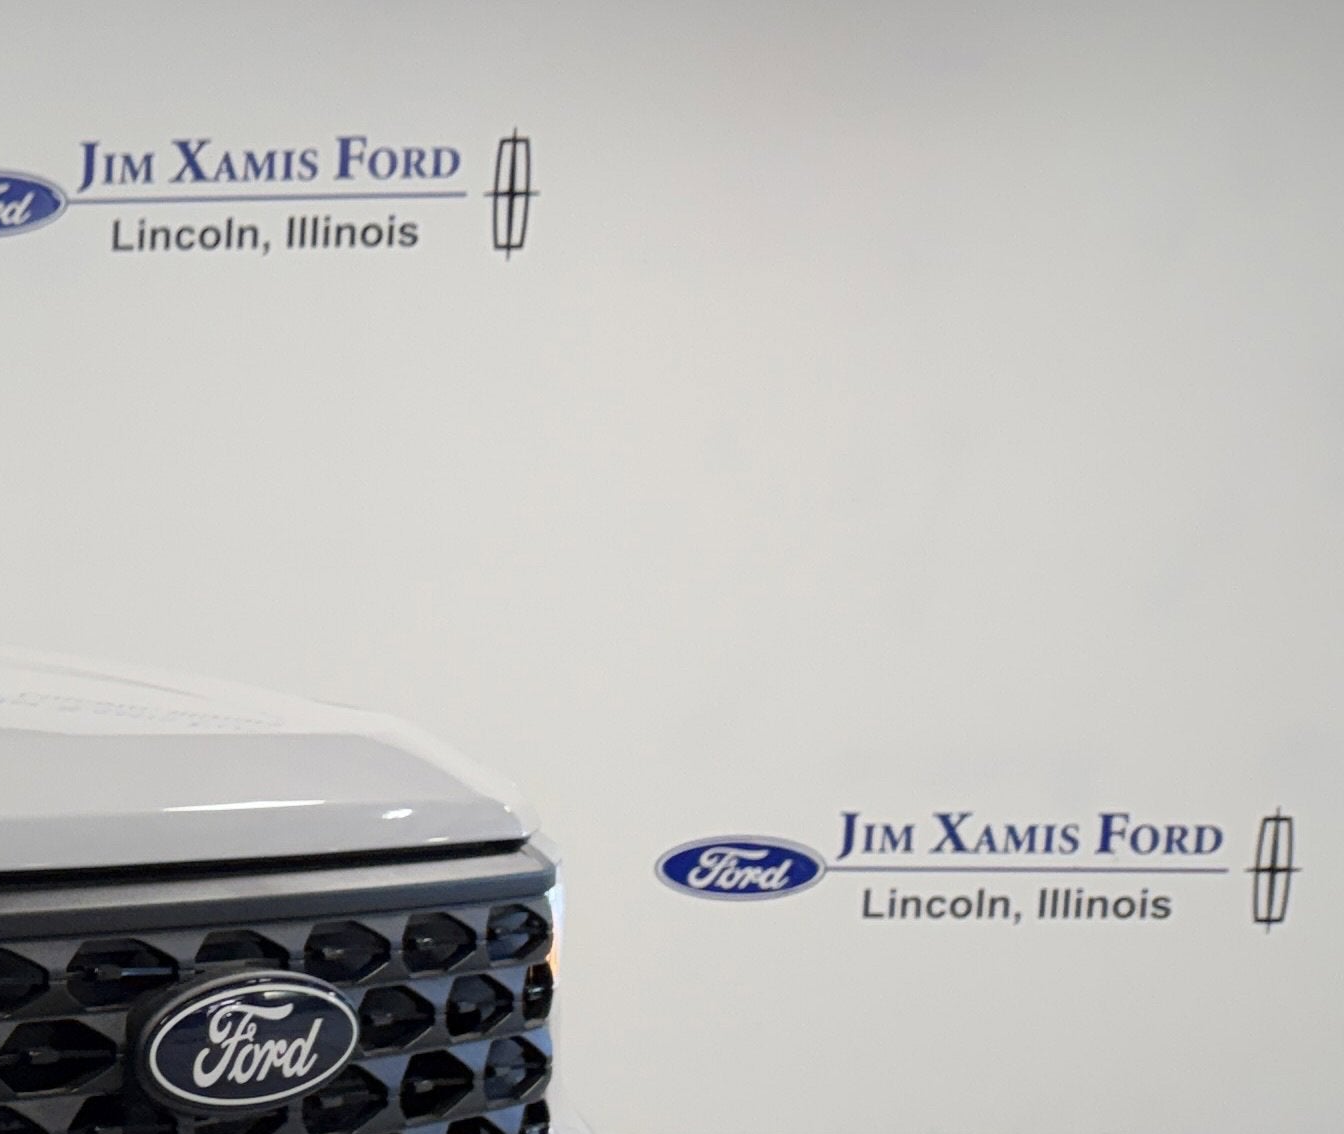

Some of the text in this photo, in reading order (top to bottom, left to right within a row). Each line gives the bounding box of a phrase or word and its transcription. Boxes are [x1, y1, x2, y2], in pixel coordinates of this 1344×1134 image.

[76, 136, 461, 193] JIM XAMIS FORD
[111, 214, 419, 255] Lincoln, Illinois
[835, 811, 1224, 861] JIM XAMIS FORD
[687, 846, 793, 890] Ford
[862, 887, 1173, 925] Lincoln, Illinois
[193, 1002, 324, 1088] Ford
